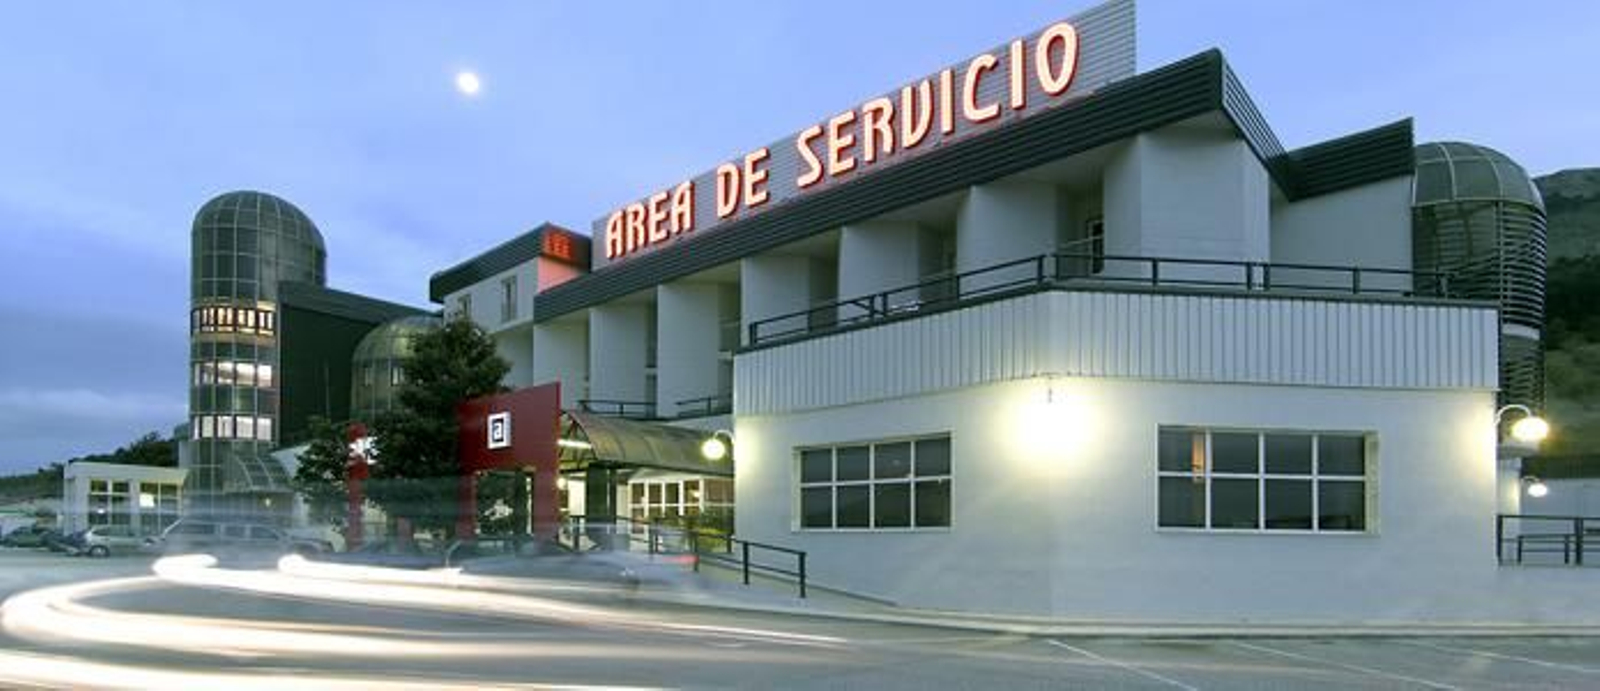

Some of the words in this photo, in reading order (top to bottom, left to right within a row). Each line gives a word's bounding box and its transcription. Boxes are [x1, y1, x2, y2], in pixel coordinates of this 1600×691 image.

[606, 180, 695, 259] AREA
[716, 148, 770, 218] DE
[796, 22, 1079, 187] SERVICIO
